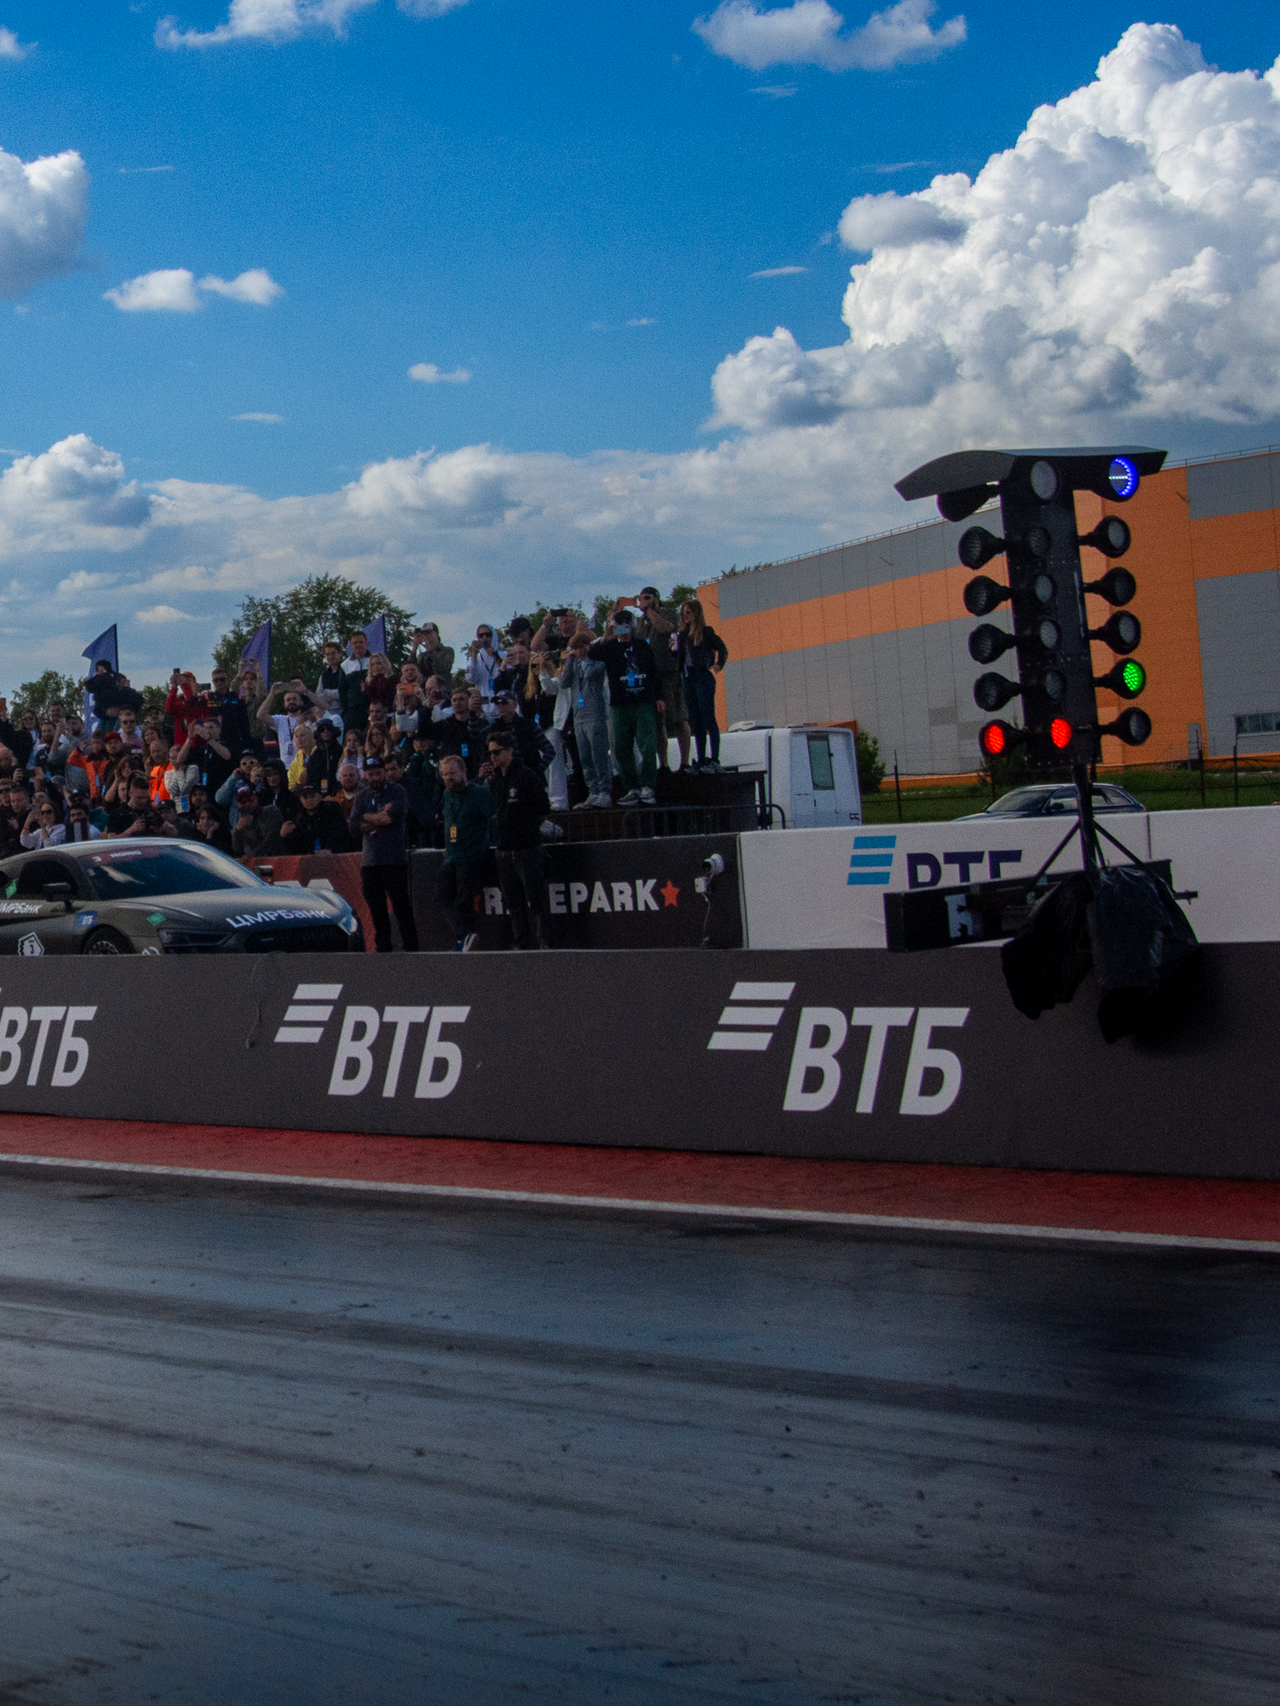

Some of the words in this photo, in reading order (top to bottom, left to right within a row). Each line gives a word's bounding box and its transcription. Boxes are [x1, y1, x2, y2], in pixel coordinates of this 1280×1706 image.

[483, 879, 659, 915] REPARK
[328, 1005, 471, 1100] ВТБ
[782, 1006, 971, 1116] ВТБ
